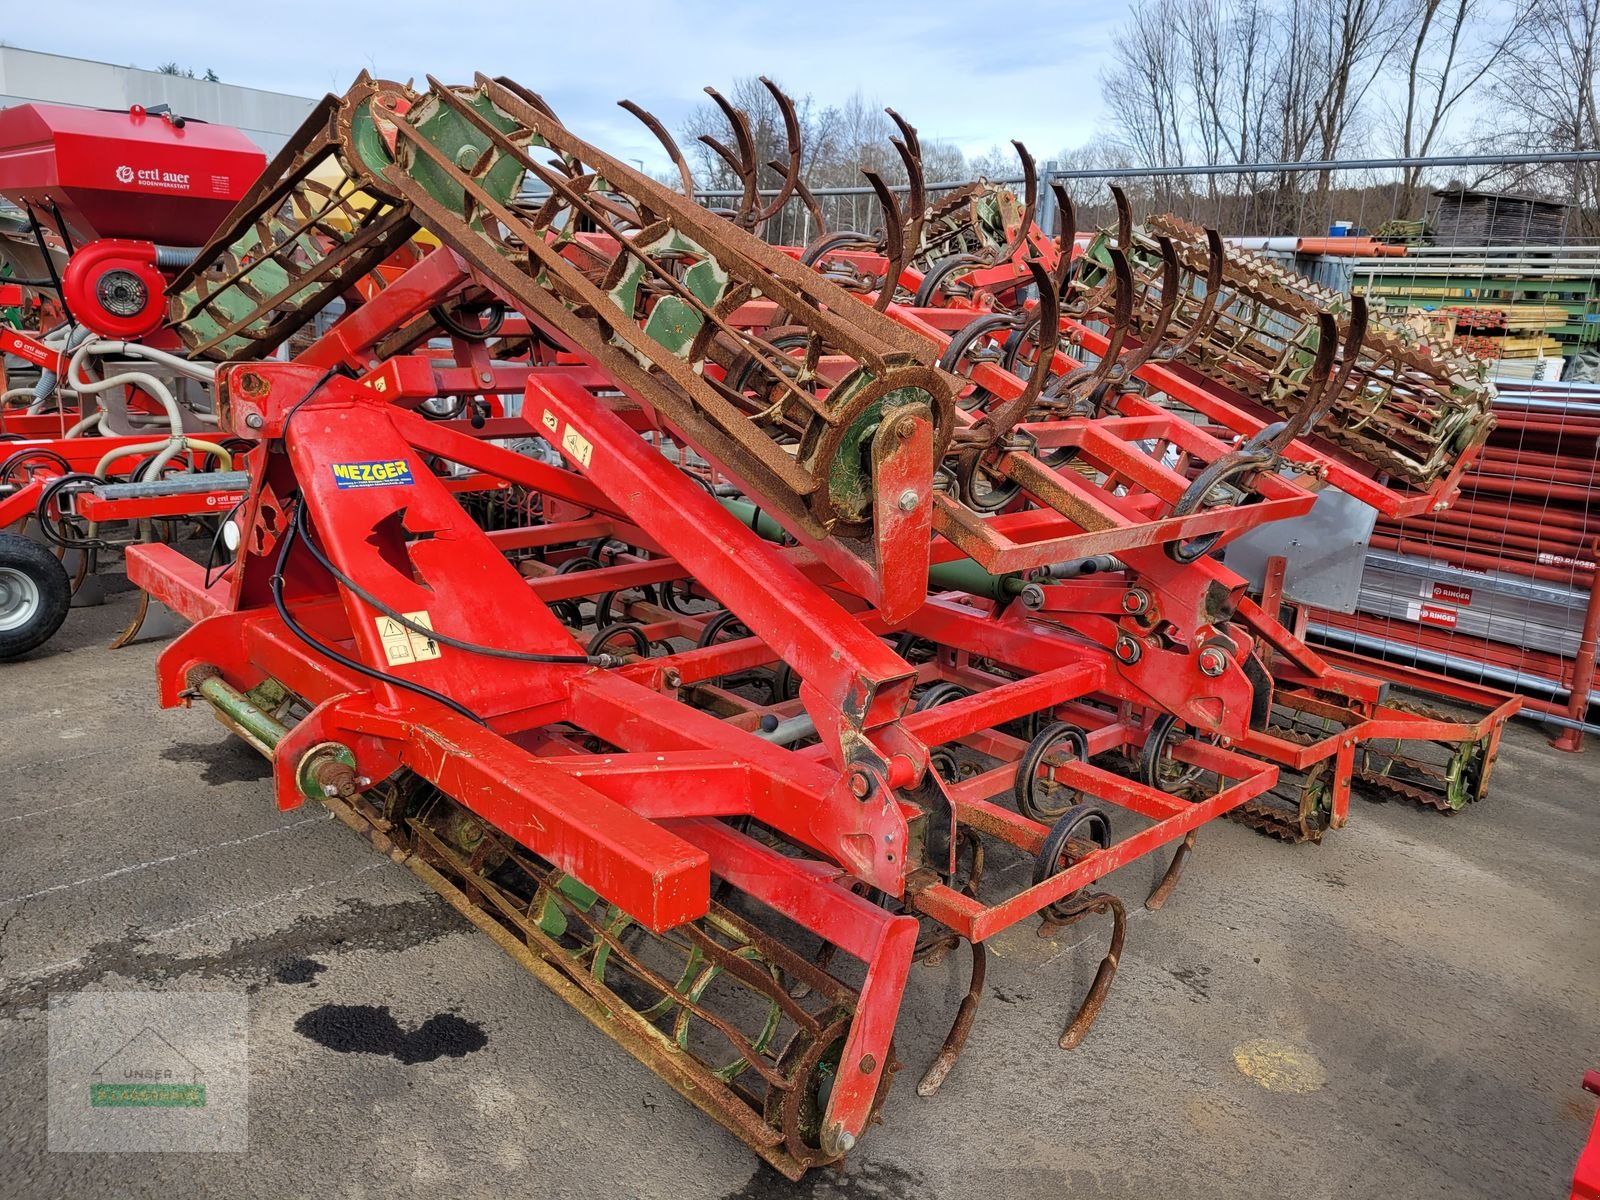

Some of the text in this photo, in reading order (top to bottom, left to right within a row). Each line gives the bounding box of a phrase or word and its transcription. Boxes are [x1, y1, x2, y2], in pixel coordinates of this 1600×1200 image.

[138, 169, 190, 184] ertl auer
[138, 180, 190, 190] BODENWERKSTATT
[332, 461, 409, 481] MEZGER
[1563, 557, 1596, 570] RINGER
[1442, 588, 1470, 601] RINGER
[1429, 612, 1456, 623] RINGER
